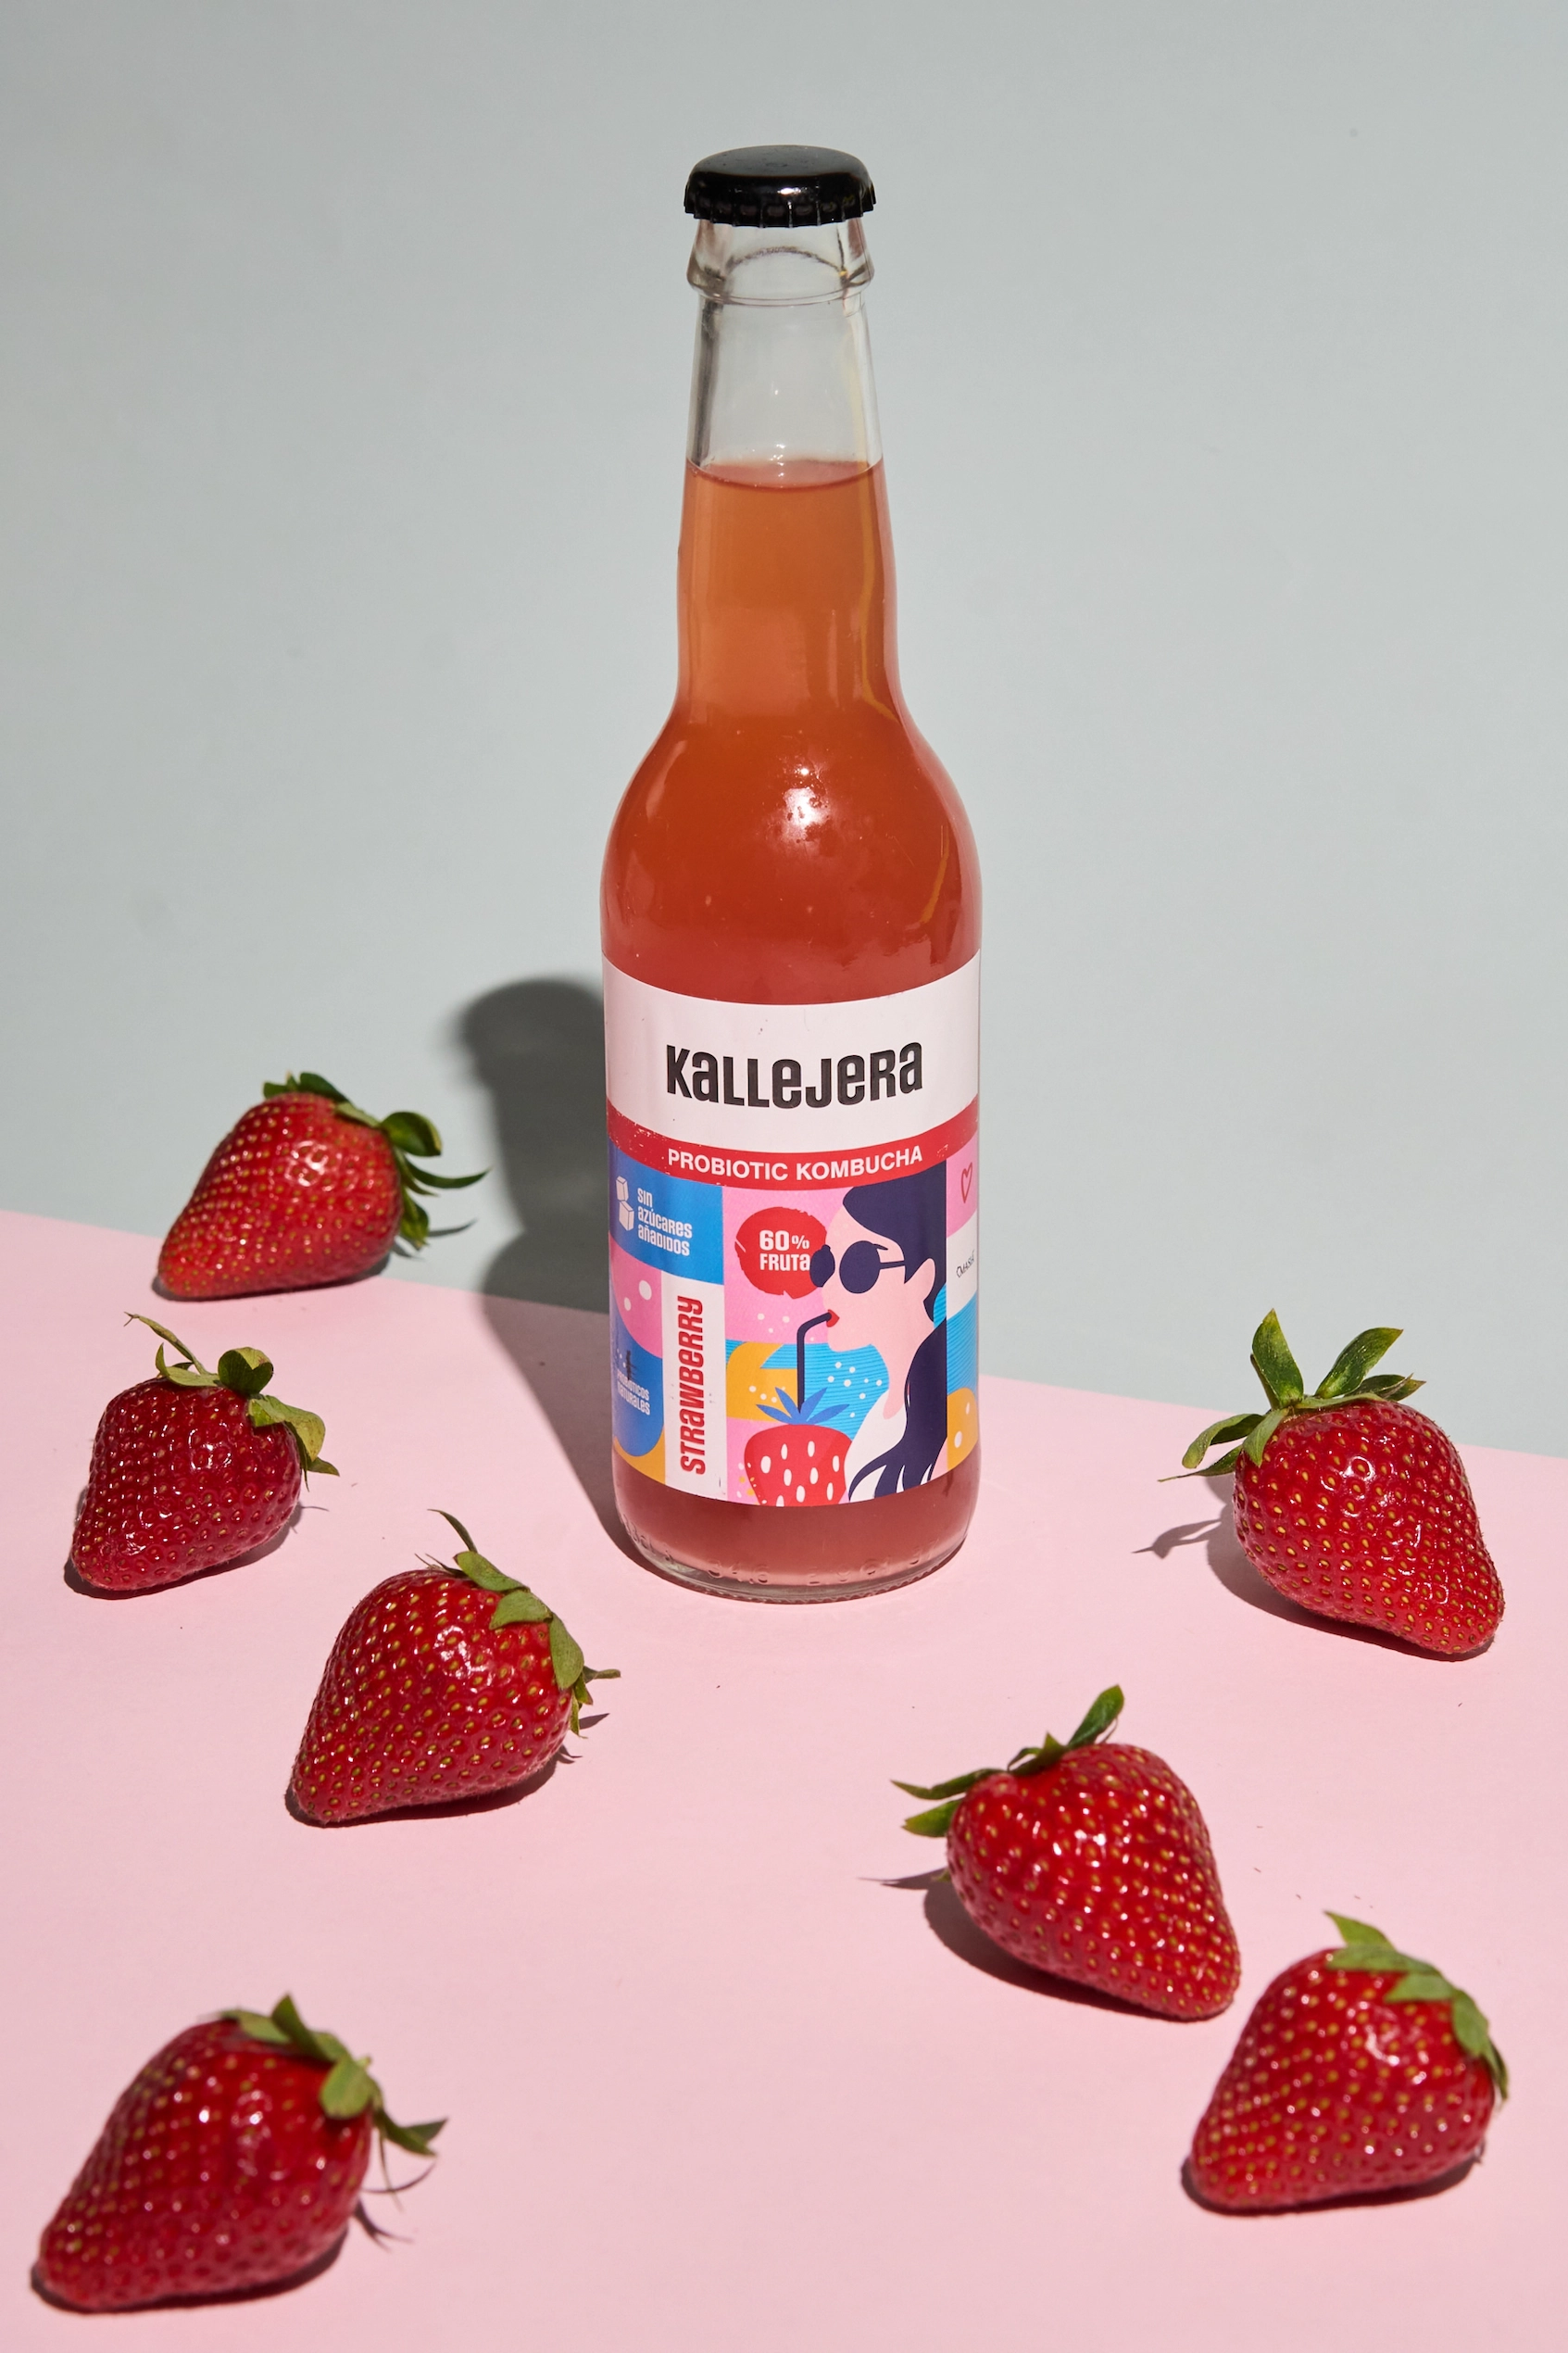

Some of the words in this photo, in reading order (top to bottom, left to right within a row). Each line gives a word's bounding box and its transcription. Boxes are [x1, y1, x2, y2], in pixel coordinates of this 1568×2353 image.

[668, 1148, 789, 1181] PROBIOTIC
[796, 1145, 923, 1181] KOMBUCHA
[759, 1229, 810, 1252] 60%
